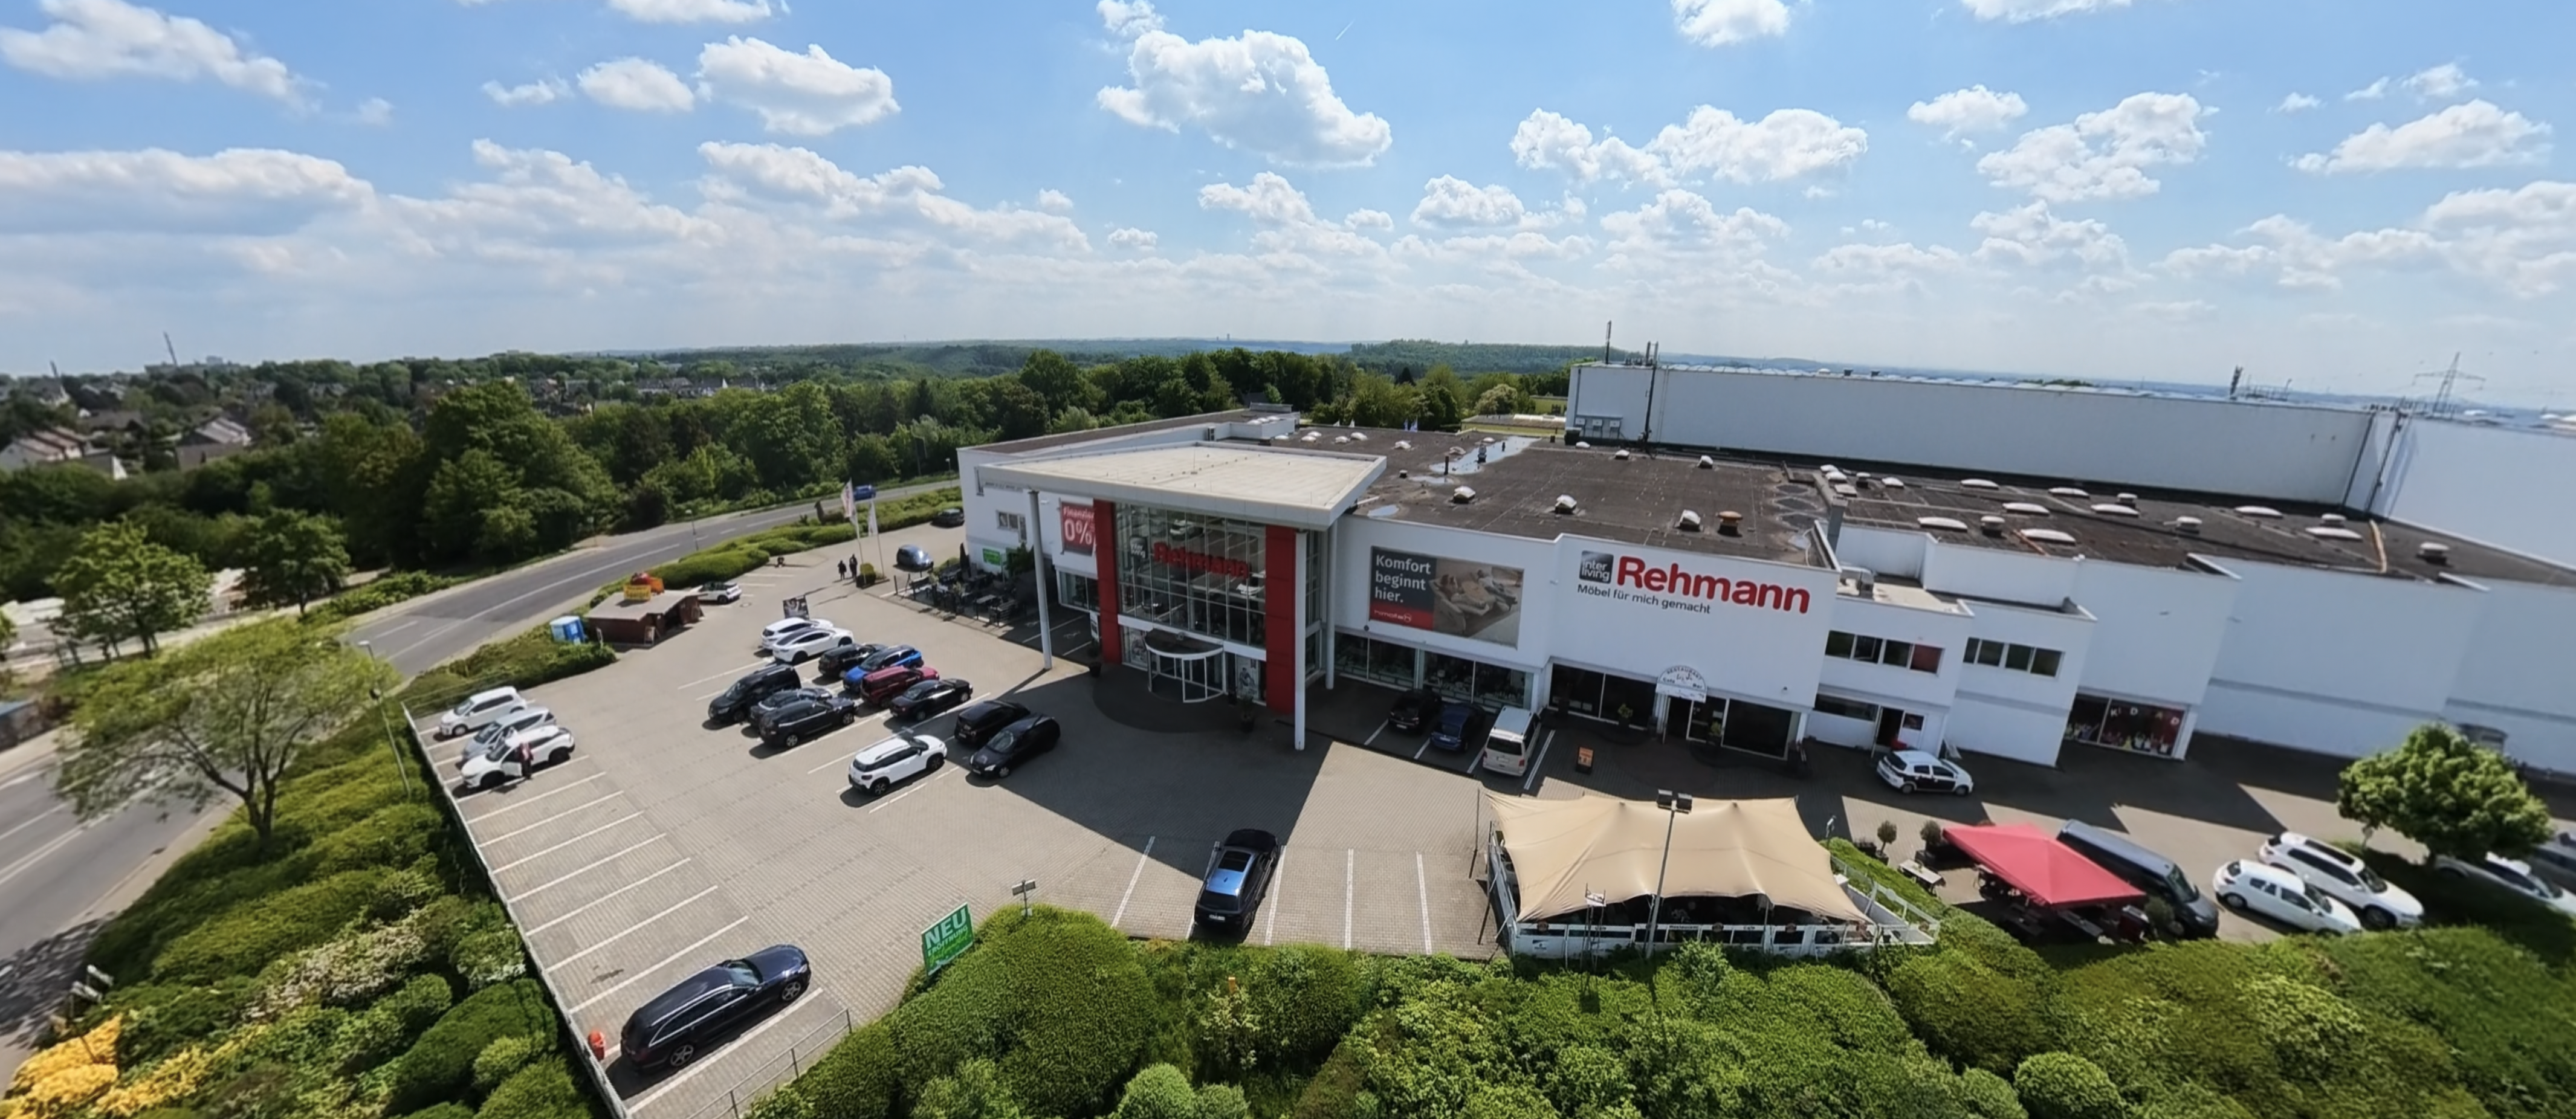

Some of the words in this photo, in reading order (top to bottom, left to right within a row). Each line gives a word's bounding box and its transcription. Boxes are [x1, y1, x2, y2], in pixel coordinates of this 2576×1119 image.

[1064, 518, 1092, 545] 0%
[1153, 542, 1249, 579] Rehmann
[1376, 555, 1431, 575] Komfort
[1581, 566, 1610, 582] living
[1376, 570, 1426, 591] beginnt
[1617, 555, 1810, 614] Rehmann
[1374, 586, 1403, 603] hier.
[1577, 584, 1610, 598] Möbel
[1613, 589, 1629, 601] für
[1632, 594, 1659, 606] mich
[1661, 598, 1710, 614] gemacht
[925, 908, 967, 949] NEU
